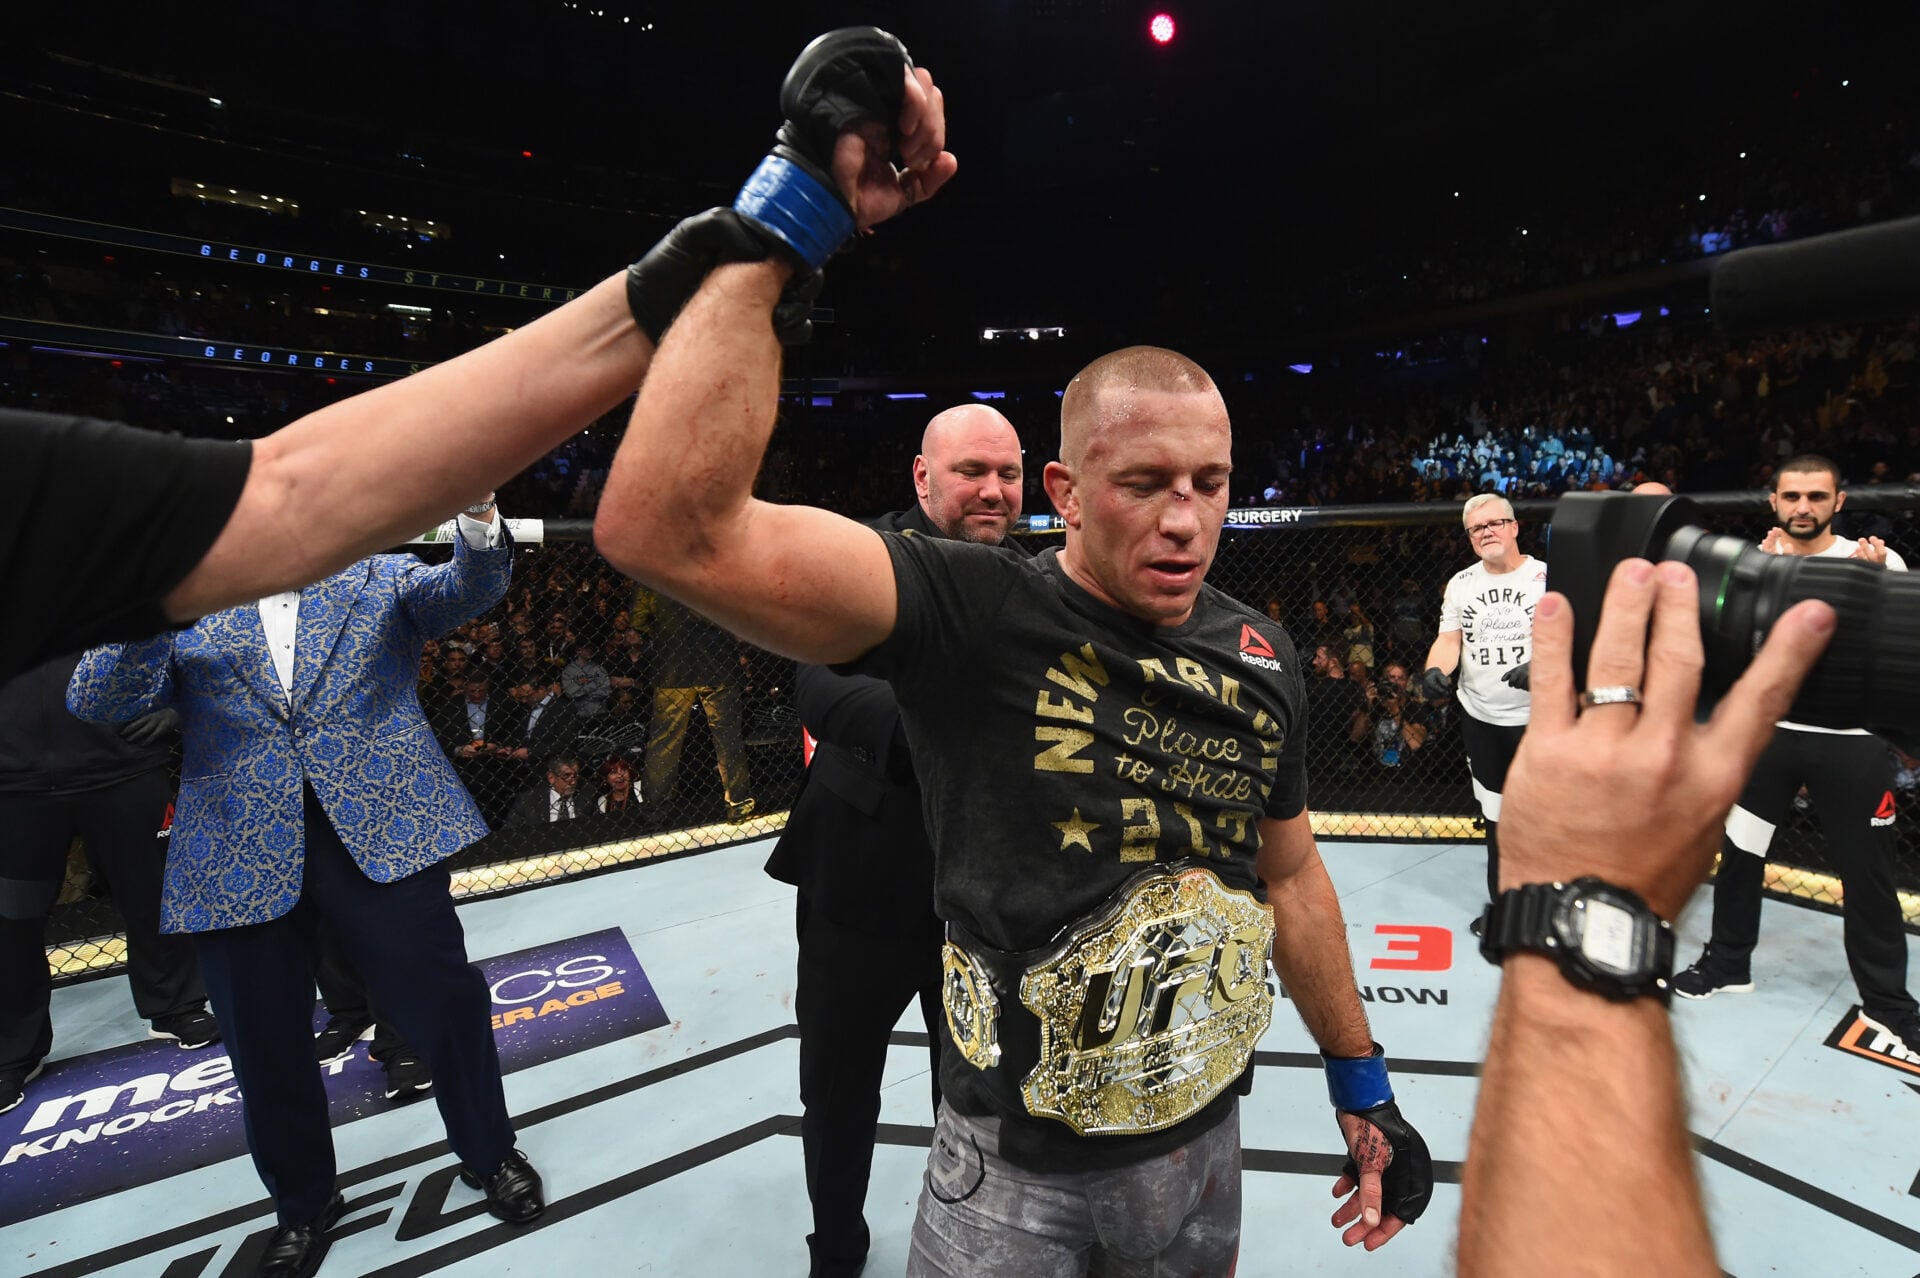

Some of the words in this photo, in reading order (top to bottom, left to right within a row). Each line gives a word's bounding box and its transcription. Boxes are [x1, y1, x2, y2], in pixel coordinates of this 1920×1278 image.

[200, 244, 369, 278] GEORGES
[404, 271, 574, 301] ST-PIERR
[204, 346, 374, 372] GEORGES
[1227, 509, 1302, 524] SURGERY
[1461, 604, 1478, 643] NEW
[1476, 588, 1527, 607] YORK
[1480, 617, 1524, 633] Place
[1239, 651, 1283, 673] Reebok
[1479, 645, 1526, 666] 217
[1034, 641, 1111, 773] NEW
[1122, 707, 1243, 762] Place
[1114, 752, 1154, 784] to
[1161, 758, 1252, 801] Hide
[1119, 798, 1255, 864] 217
[1369, 924, 1453, 972] 3
[1072, 927, 1262, 1052] UFC
[1360, 985, 1448, 1006] NOW
